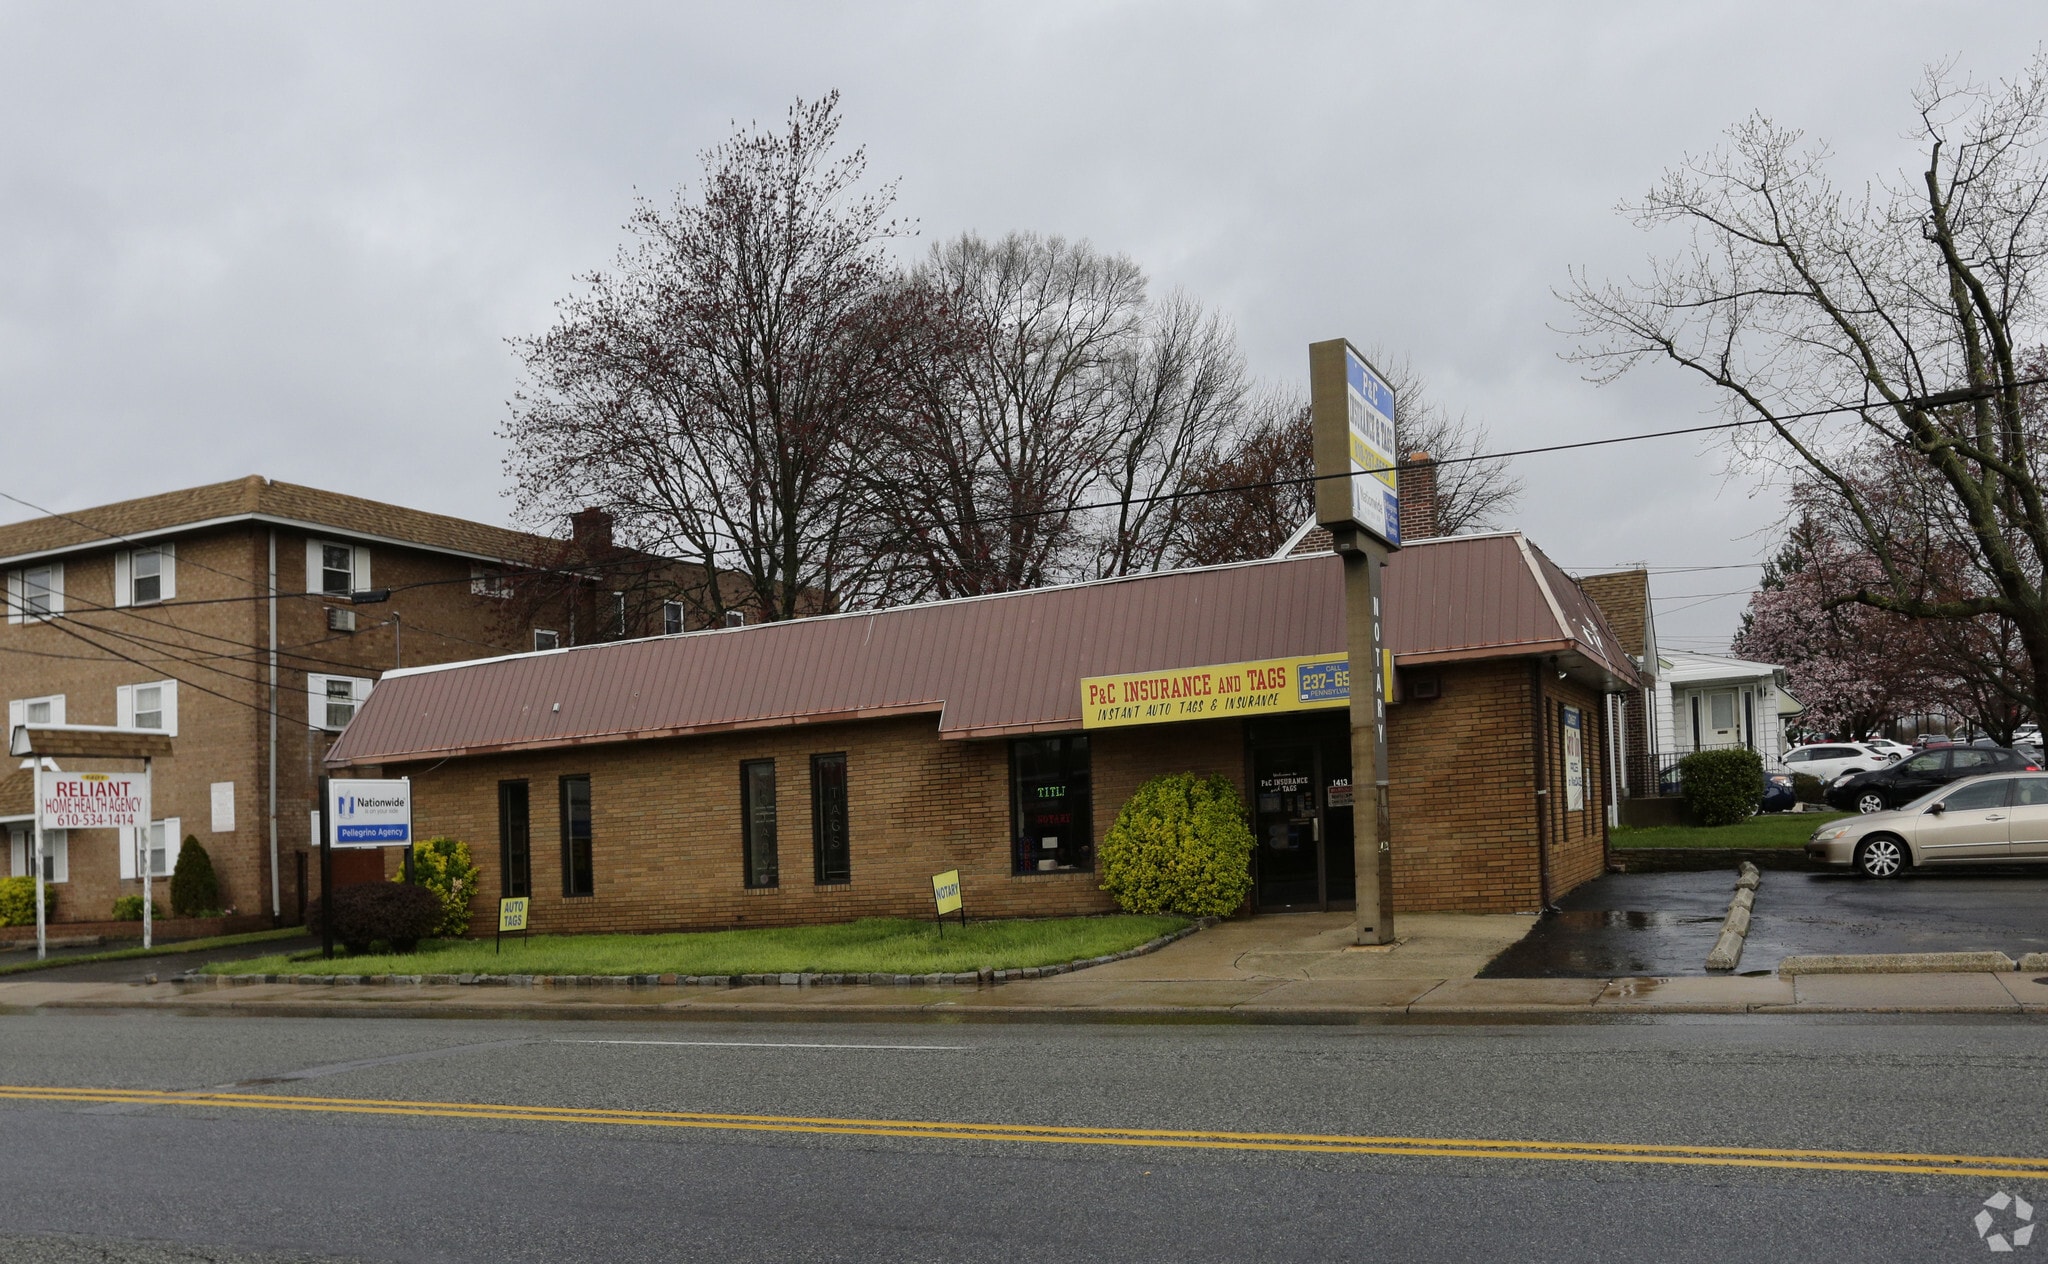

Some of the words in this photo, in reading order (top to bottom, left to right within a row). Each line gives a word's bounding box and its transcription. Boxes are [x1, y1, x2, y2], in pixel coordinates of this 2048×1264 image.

[1363, 371, 1378, 406] P&C
[1373, 596, 1384, 744] NOTARY
[1089, 683, 1116, 706] P&C
[1123, 674, 1212, 703] INSURANCE
[1218, 675, 1241, 694] AND
[1247, 667, 1287, 690] TAGS
[1302, 671, 1350, 691] 237-65
[1098, 705, 1142, 722] INSTANT
[1146, 703, 1172, 717] AUTO
[1180, 699, 1204, 714] TAGS
[1210, 698, 1218, 711] &
[1225, 692, 1280, 710] INSURANCE
[56, 781, 131, 797] RELIANT
[1273, 777, 1309, 786] INSURANCE
[1333, 779, 1348, 787] 1413
[45, 798, 73, 814] HOME
[74, 797, 107, 813] HEALTH
[109, 797, 142, 813] AGENCY
[357, 797, 405, 808] Nationwide
[57, 813, 135, 827] 610-534-1414
[830, 787, 841, 850] TAGS
[342, 828, 377, 838] Pellegrino
[378, 828, 404, 838] Agency
[936, 883, 958, 900] NOTARY
[504, 901, 524, 913] AUTO
[504, 915, 522, 927] TAGS
